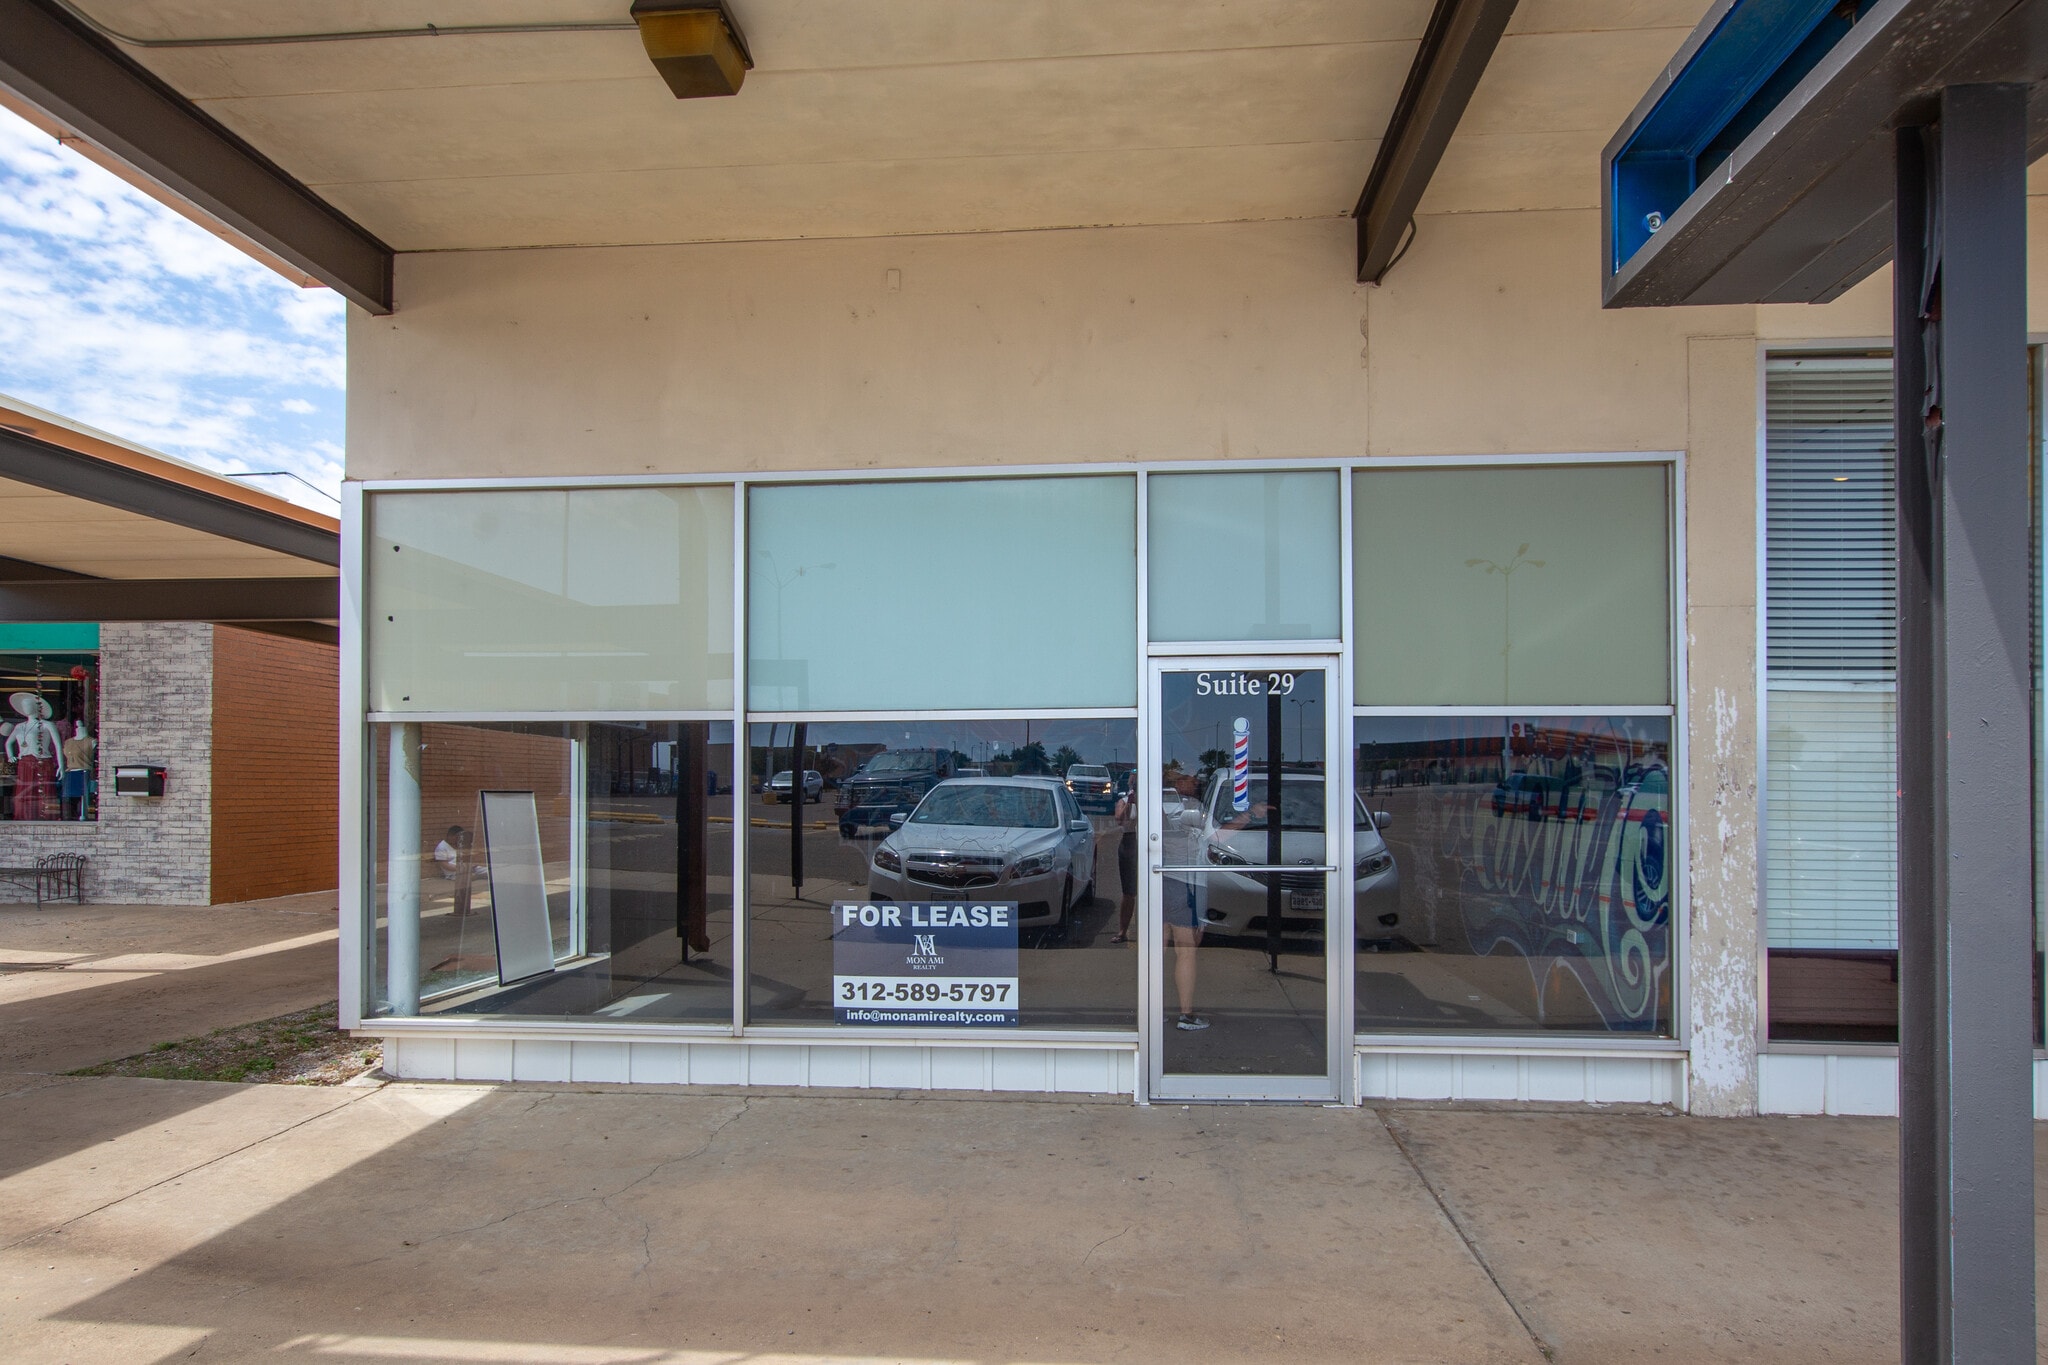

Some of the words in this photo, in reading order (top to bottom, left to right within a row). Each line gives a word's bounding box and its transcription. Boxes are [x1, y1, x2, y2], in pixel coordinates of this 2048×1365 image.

[1196, 672, 1260, 696] Suite
[1267, 672, 1295, 696] 29
[842, 905, 902, 927] FOR
[911, 905, 1009, 927] LEASE
[906, 956, 926, 965] MON
[928, 956, 945, 965] AMI
[841, 982, 1011, 1002] 312-589-5797
[846, 1009, 1005, 1024] info@monamirealty.com
